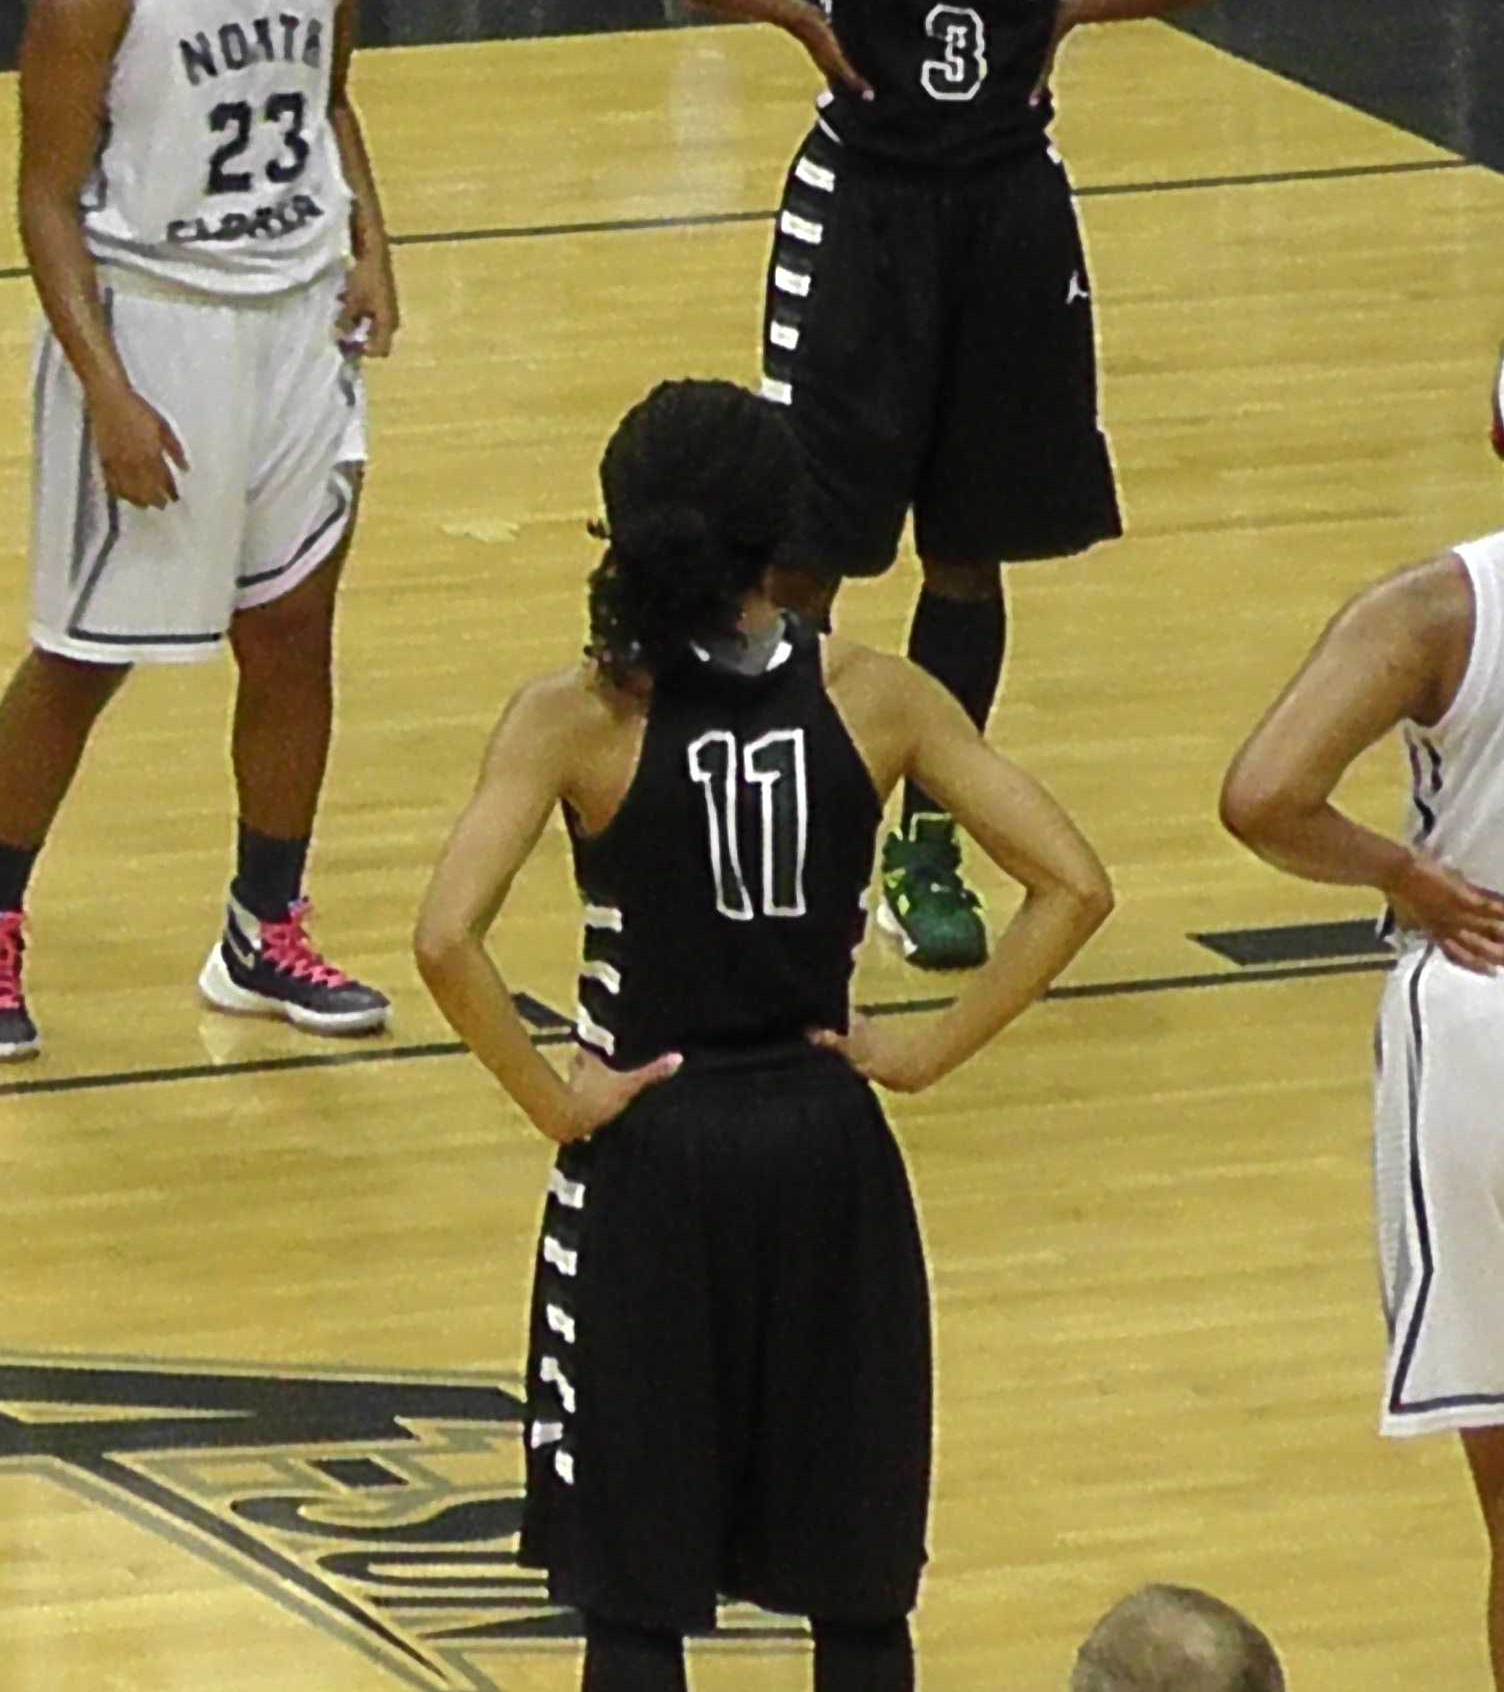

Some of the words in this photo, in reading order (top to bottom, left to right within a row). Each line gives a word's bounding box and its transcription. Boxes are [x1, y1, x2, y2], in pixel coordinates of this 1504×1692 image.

[921, 4, 988, 101] 3
[205, 92, 310, 194] 23
[688, 728, 808, 921] 11
